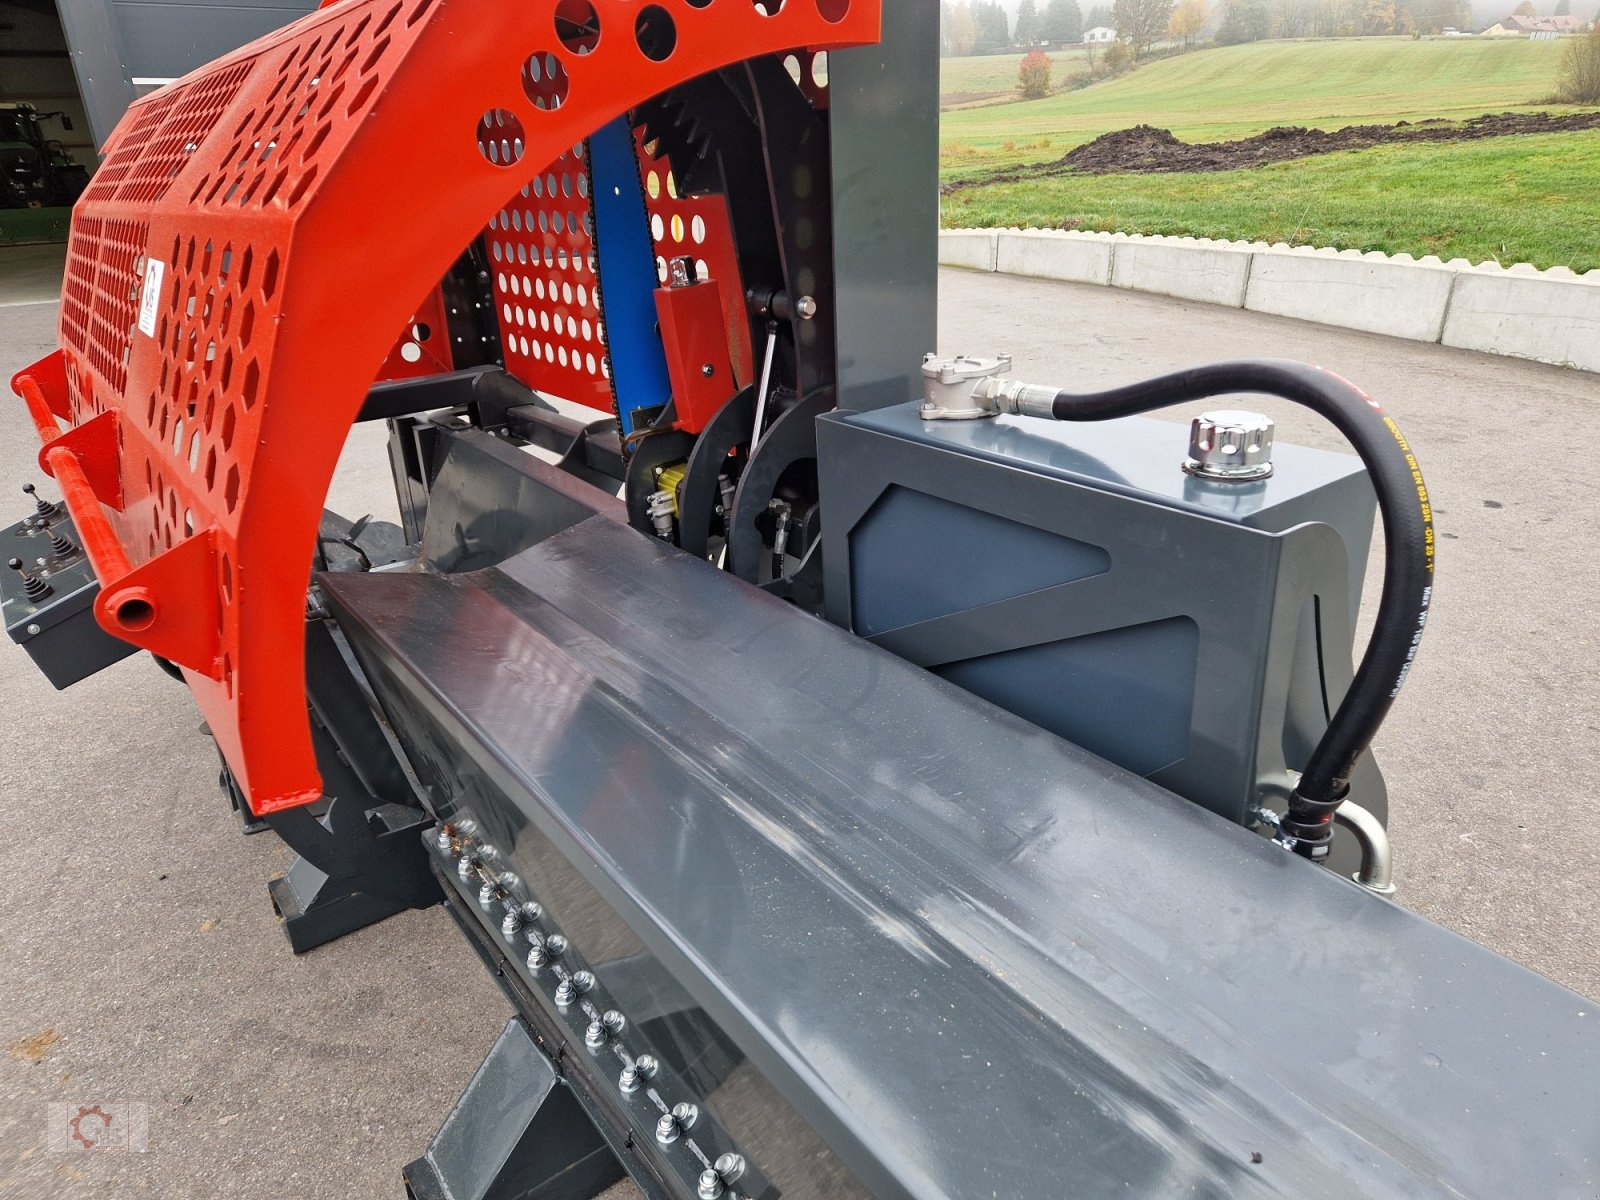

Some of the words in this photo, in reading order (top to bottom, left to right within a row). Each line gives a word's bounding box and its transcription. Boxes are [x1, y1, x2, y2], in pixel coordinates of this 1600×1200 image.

[1383, 416, 1410, 451] SMOOTH
[1405, 454, 1418, 470] DIN
[1412, 470, 1422, 485] EN
[1421, 586, 1432, 607] Max
[1417, 611, 1428, 627] WP
[1406, 646, 1418, 661] Bar
